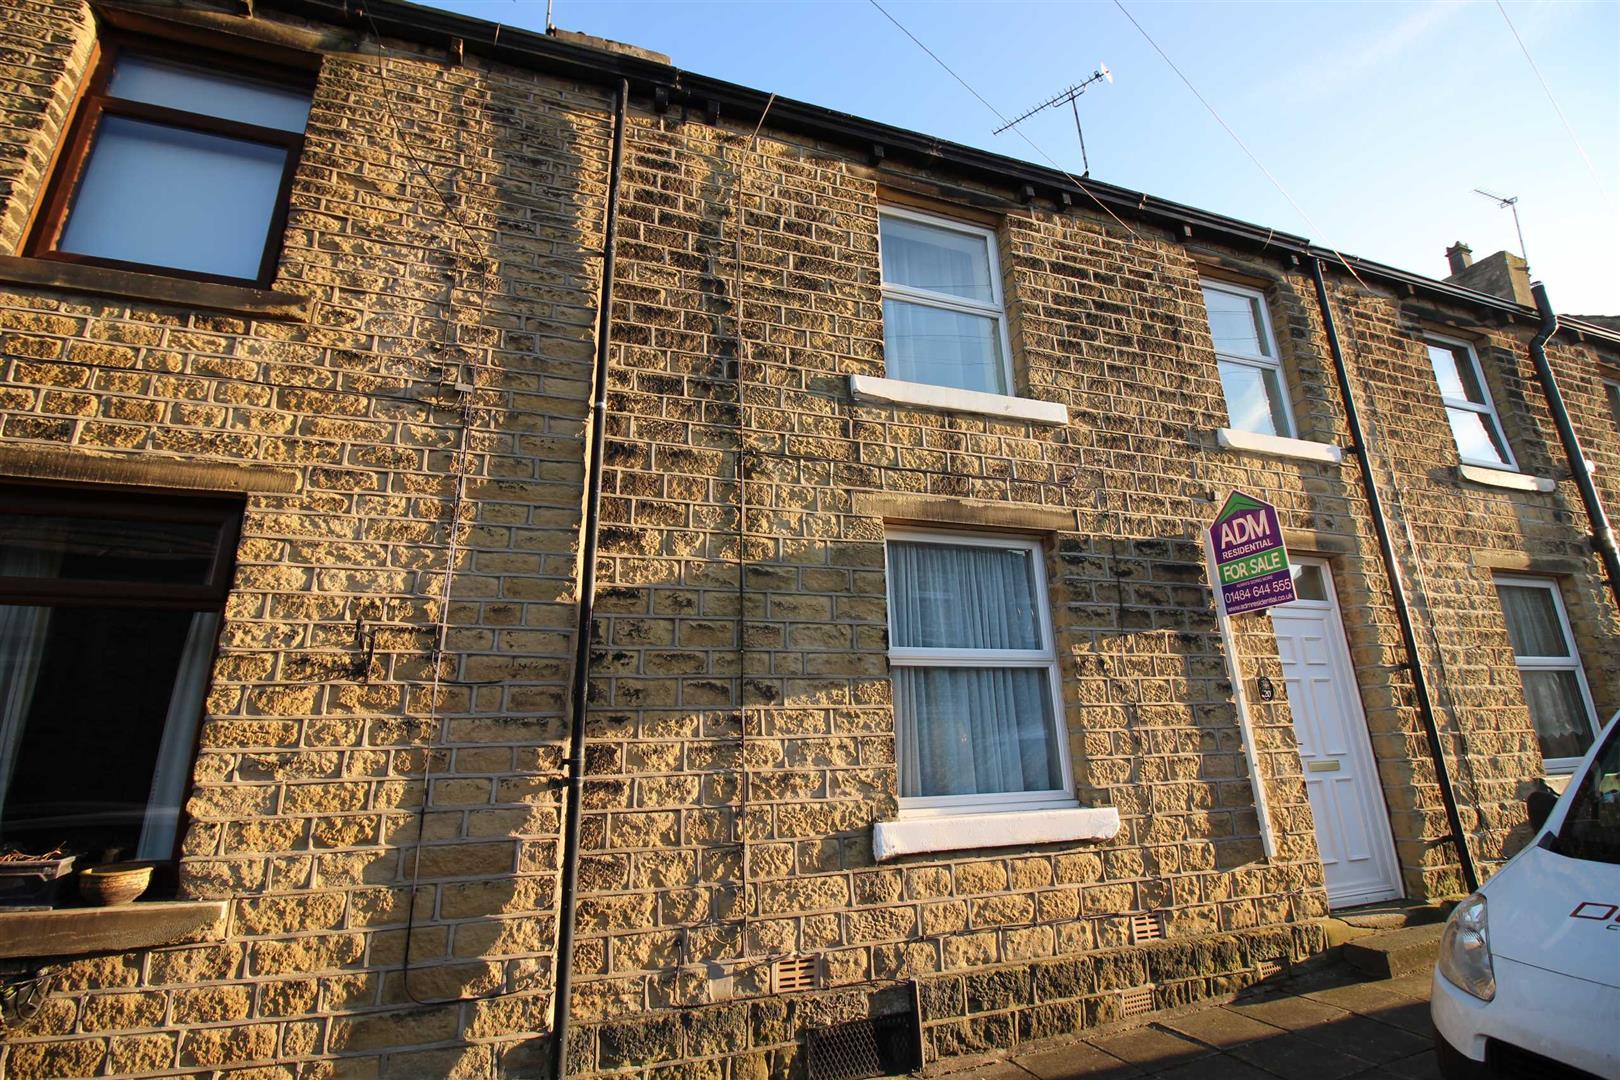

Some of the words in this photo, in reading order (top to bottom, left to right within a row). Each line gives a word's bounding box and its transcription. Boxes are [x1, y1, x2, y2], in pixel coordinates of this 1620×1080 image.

[1221, 509, 1271, 549] ADM
[1222, 538, 1273, 559] RESIDENTIAL
[1223, 563, 1248, 581] FOR
[1250, 552, 1281, 574] SALE
[1225, 589, 1251, 604] 01484
[1253, 583, 1270, 597] 644
[1272, 578, 1291, 593] 555
[1227, 592, 1294, 612] www.admresidential.co.uk
